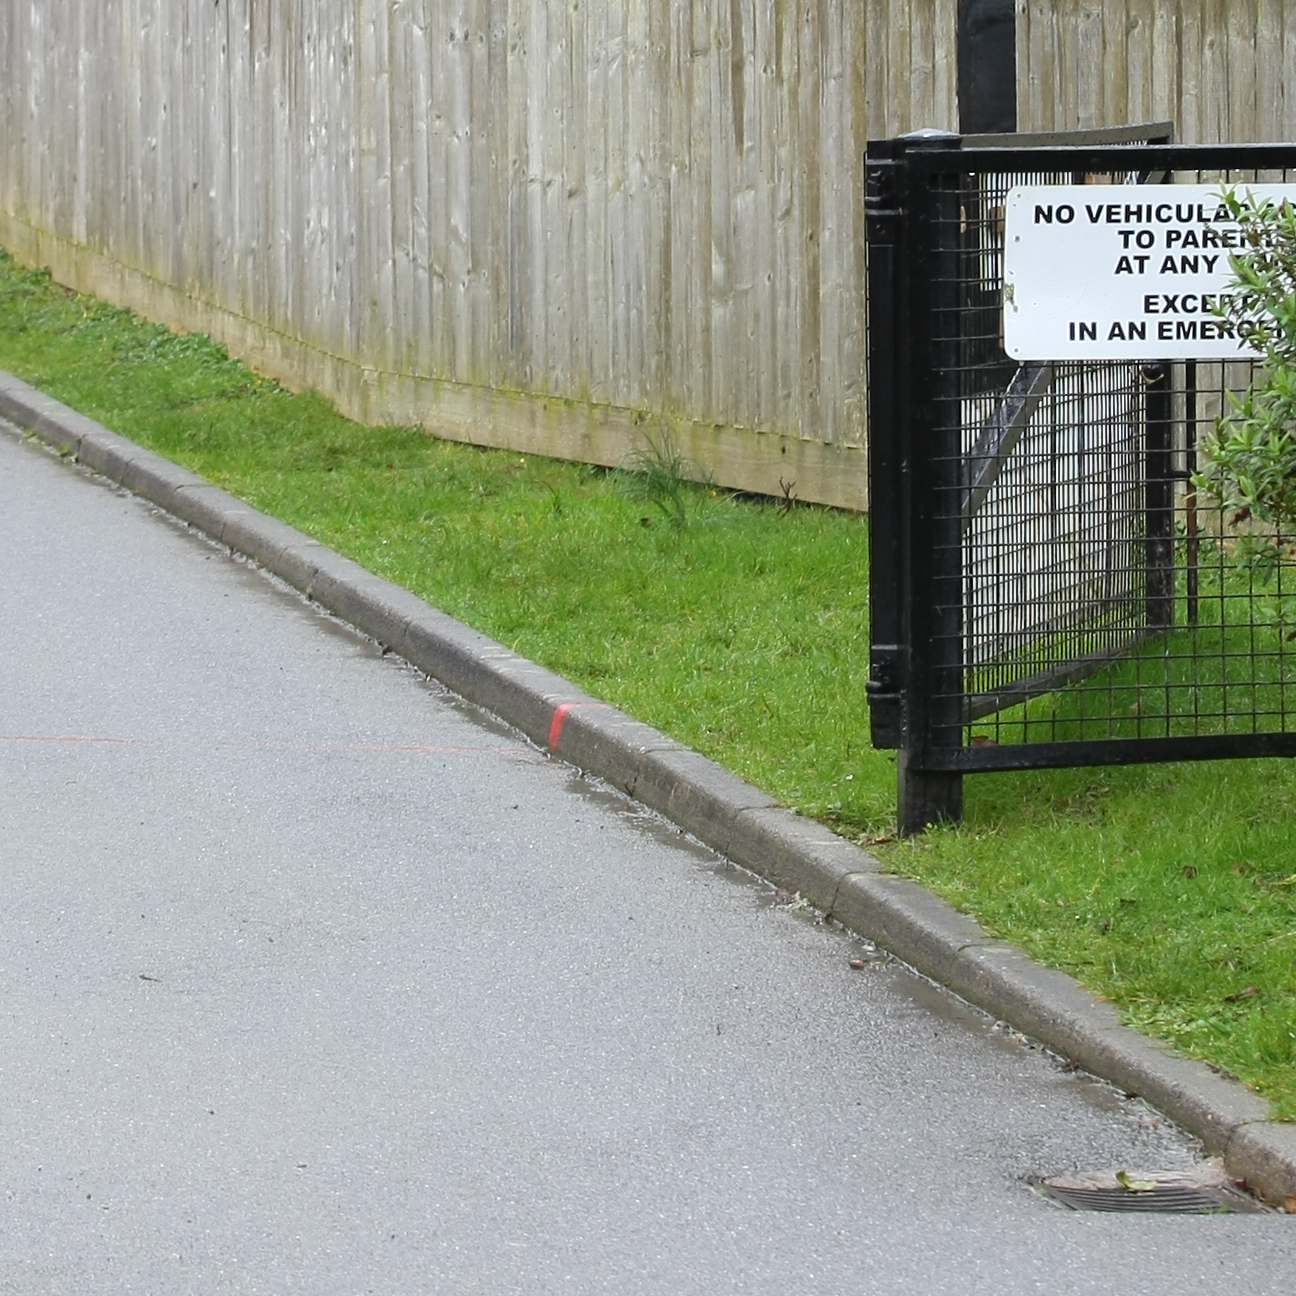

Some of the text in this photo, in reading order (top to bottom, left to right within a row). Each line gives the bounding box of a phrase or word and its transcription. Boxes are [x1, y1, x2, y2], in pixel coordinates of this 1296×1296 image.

[1034, 204, 1075, 224] NO
[1118, 230, 1155, 249] TO
[1115, 255, 1151, 274] AT
[1160, 255, 1220, 274] ANY
[1069, 322, 1097, 341] IN
[1107, 322, 1147, 341] AN
